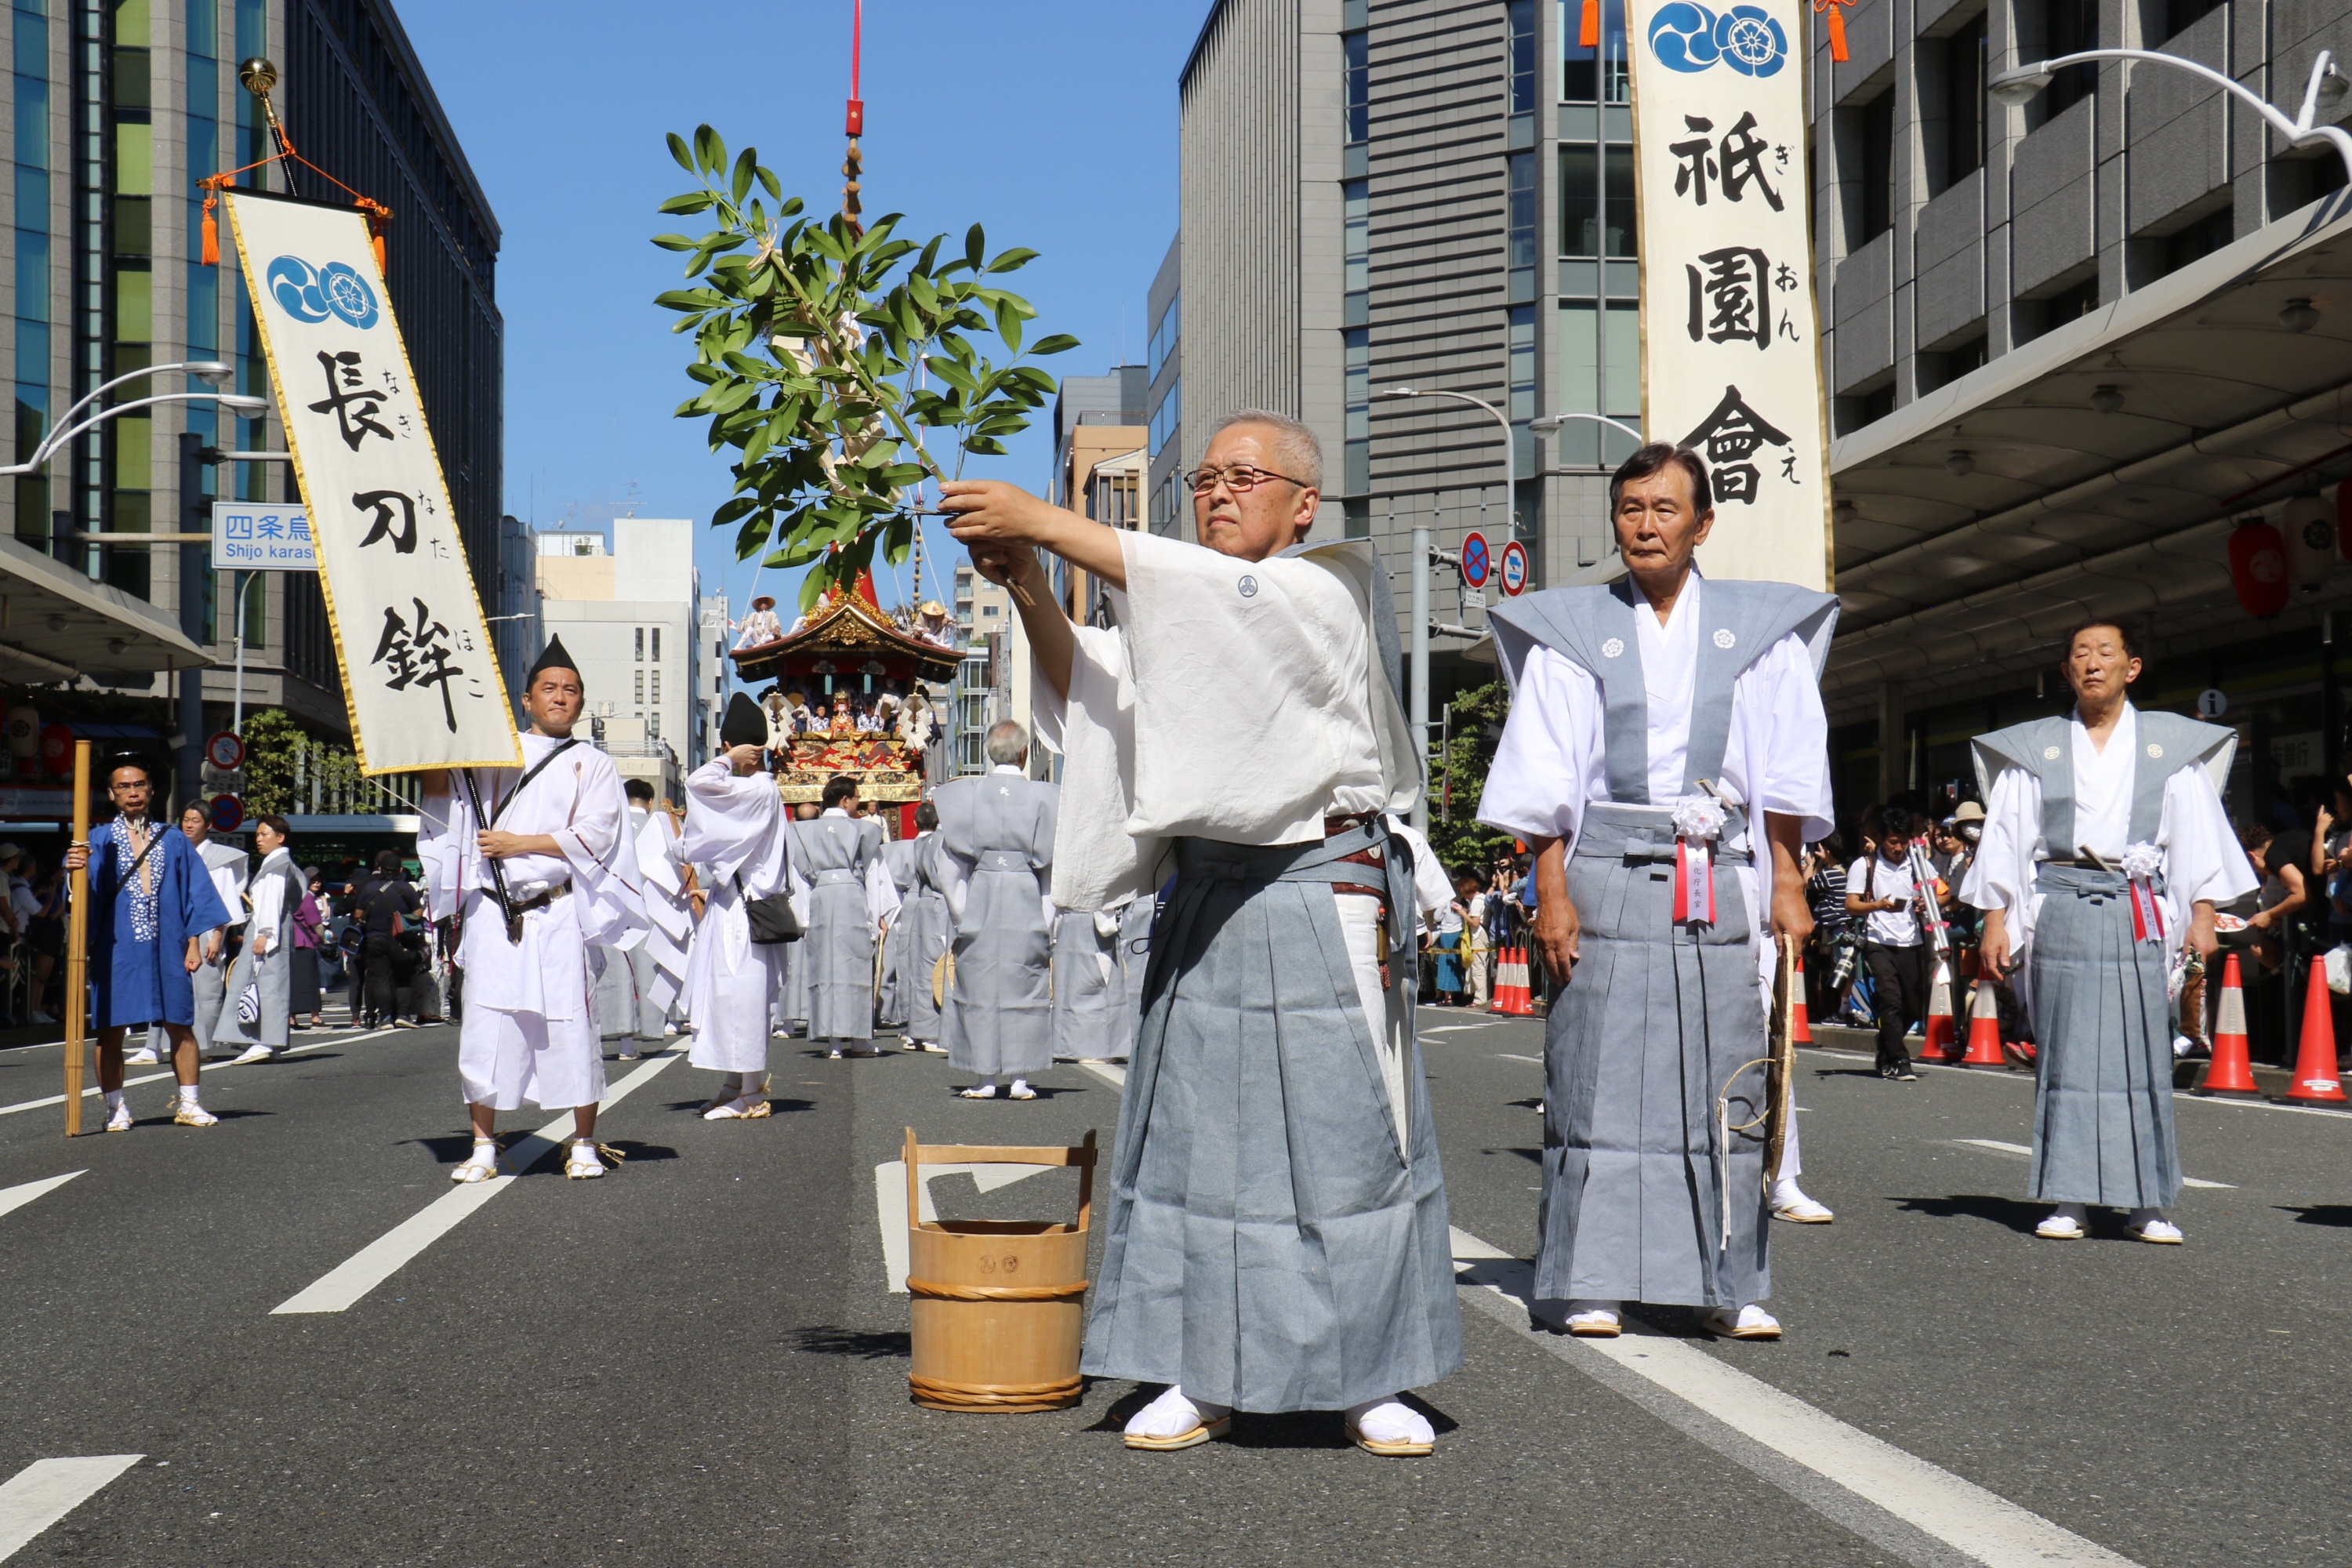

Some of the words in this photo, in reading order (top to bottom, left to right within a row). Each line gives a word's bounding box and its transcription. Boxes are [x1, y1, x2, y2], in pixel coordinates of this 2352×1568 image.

[226, 543, 263, 561] Shijo
[308, 351, 463, 734] 長刀鉾
[1467, 594, 1485, 604] ここから
[1693, 857, 1702, 909] 文化庁長官
